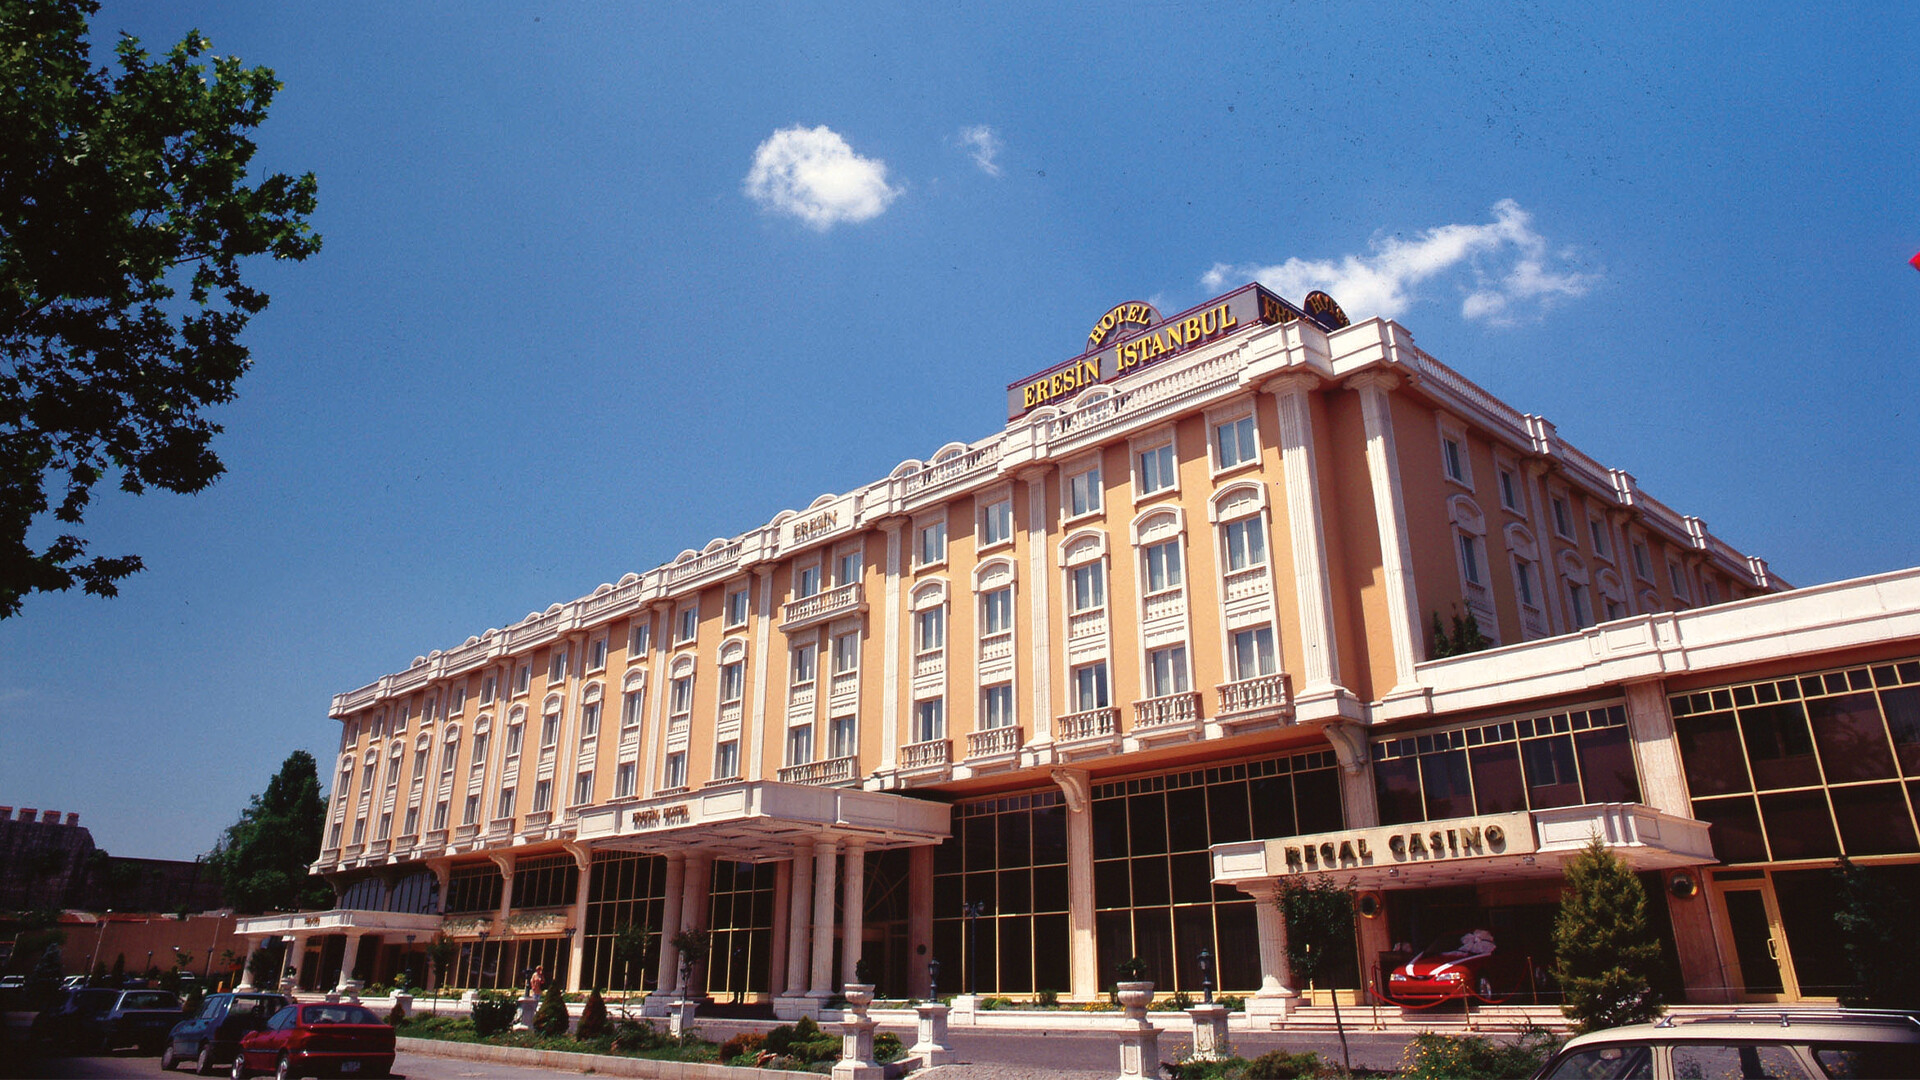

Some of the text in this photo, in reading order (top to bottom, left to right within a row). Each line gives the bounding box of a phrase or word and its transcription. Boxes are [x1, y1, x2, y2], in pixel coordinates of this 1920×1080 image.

[1089, 304, 1151, 345] HOTEL
[1023, 303, 1237, 409] ERESİN İSTANBUL
[1284, 825, 1505, 865] REGAL CASINO
